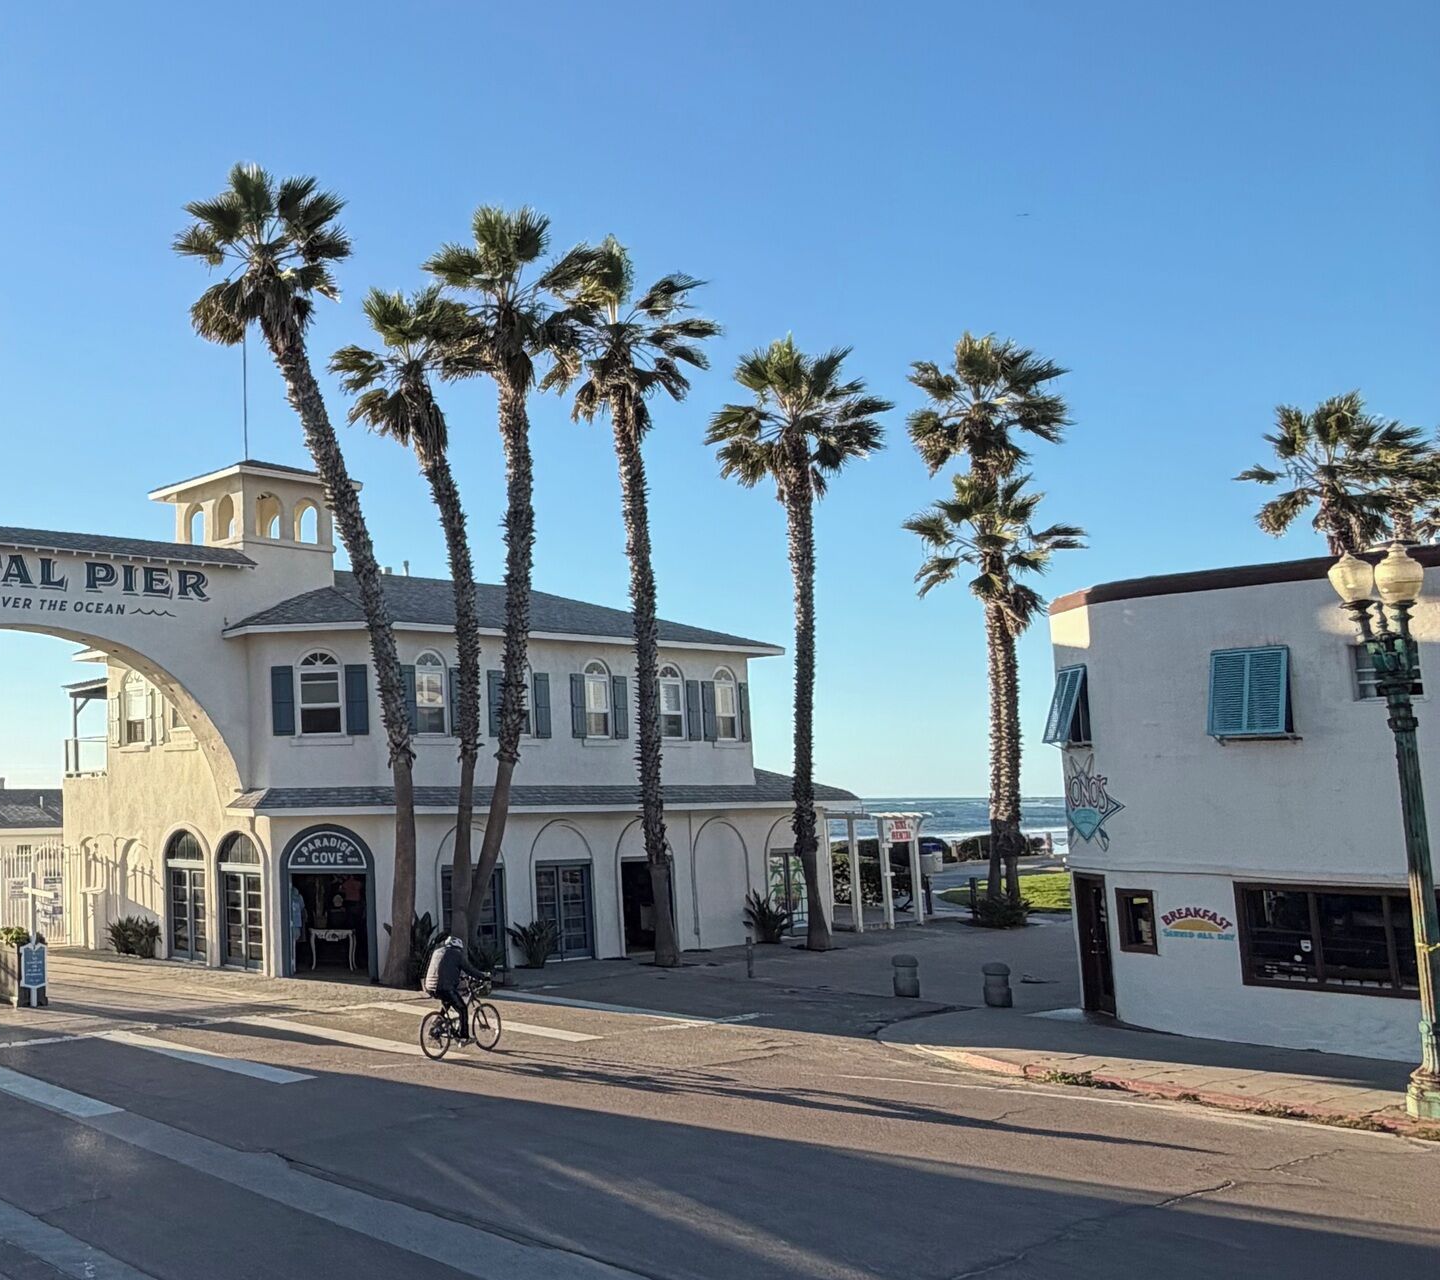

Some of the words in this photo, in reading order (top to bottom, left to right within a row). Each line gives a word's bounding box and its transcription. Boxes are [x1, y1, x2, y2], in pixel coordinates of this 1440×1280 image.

[85, 561, 210, 601] PIER
[39, 599, 68, 612] THE
[73, 600, 126, 616] OCEAN
[301, 838, 354, 855] PARADISE
[311, 852, 343, 864] COVE
[1161, 907, 1233, 929] BREAKFAST
[1217, 933, 1236, 941] DAY
